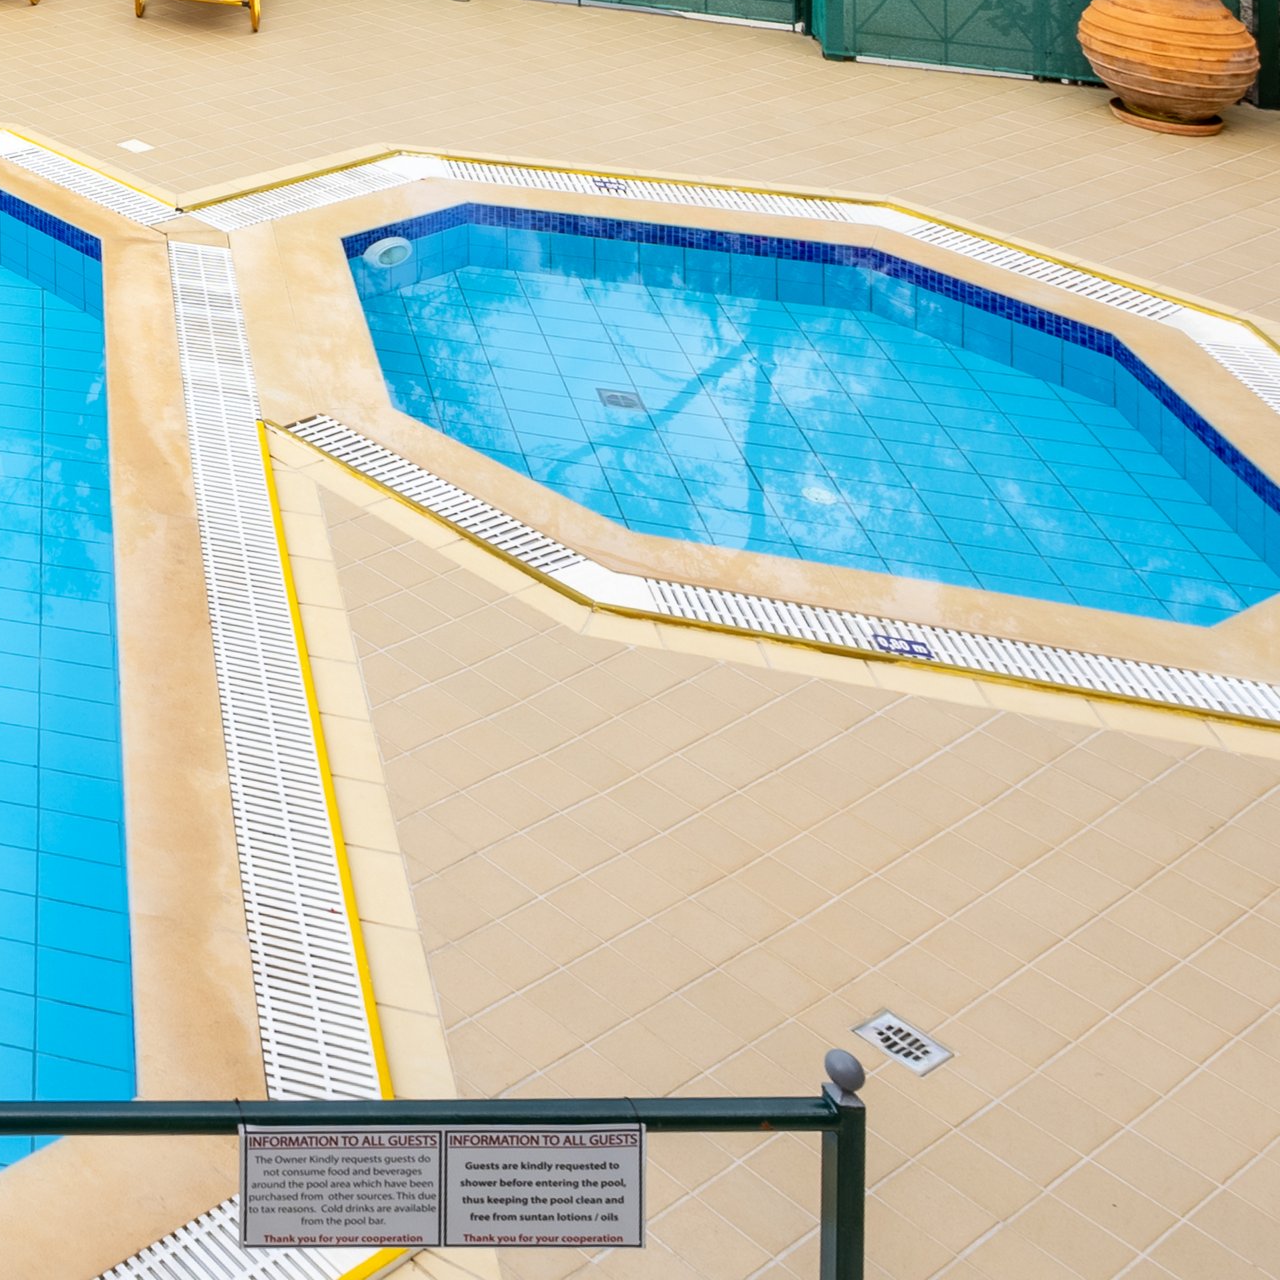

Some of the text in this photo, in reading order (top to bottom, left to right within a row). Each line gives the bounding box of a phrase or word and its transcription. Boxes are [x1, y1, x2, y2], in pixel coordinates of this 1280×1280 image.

[249, 1134, 437, 1146] INFORMATION TO ALL GUESTS
[450, 1133, 638, 1146] INFORMATION TO ALL GUESTS
[255, 1155, 431, 1165] The Owner Kindly requests guests do
[465, 1162, 500, 1170] Guests
[521, 1162, 553, 1172] kindly
[555, 1161, 607, 1172] requested
[609, 1162, 620, 1170] to
[263, 1167, 423, 1178] not consume food and beverages
[251, 1180, 286, 1189] around
[288, 1180, 304, 1189] the
[306, 1180, 328, 1190] pool
[353, 1180, 382, 1188] which
[384, 1179, 408, 1188] have
[409, 1179, 434, 1188] been
[460, 1178, 627, 1190] shower before entering the pool,
[249, 1192, 299, 1203] purchased
[301, 1192, 324, 1201] from
[328, 1192, 355, 1201] other
[396, 1191, 416, 1200] This
[418, 1192, 437, 1201] due
[462, 1196, 625, 1206] thus keeping the pool clean and
[249, 1206, 259, 1214] to
[261, 1206, 276, 1214] tax
[321, 1204, 343, 1213] Cold
[345, 1204, 375, 1213] drinks
[394, 1204, 437, 1213] available
[301, 1216, 386, 1227] from the pool bar.
[470, 1212, 491, 1222] free
[493, 1212, 517, 1221] from
[557, 1213, 593, 1222] lotions
[600, 1213, 619, 1222] oils
[264, 1234, 423, 1244] Thank you for your cooperation
[463, 1234, 624, 1244] Thank you for your cooperation
